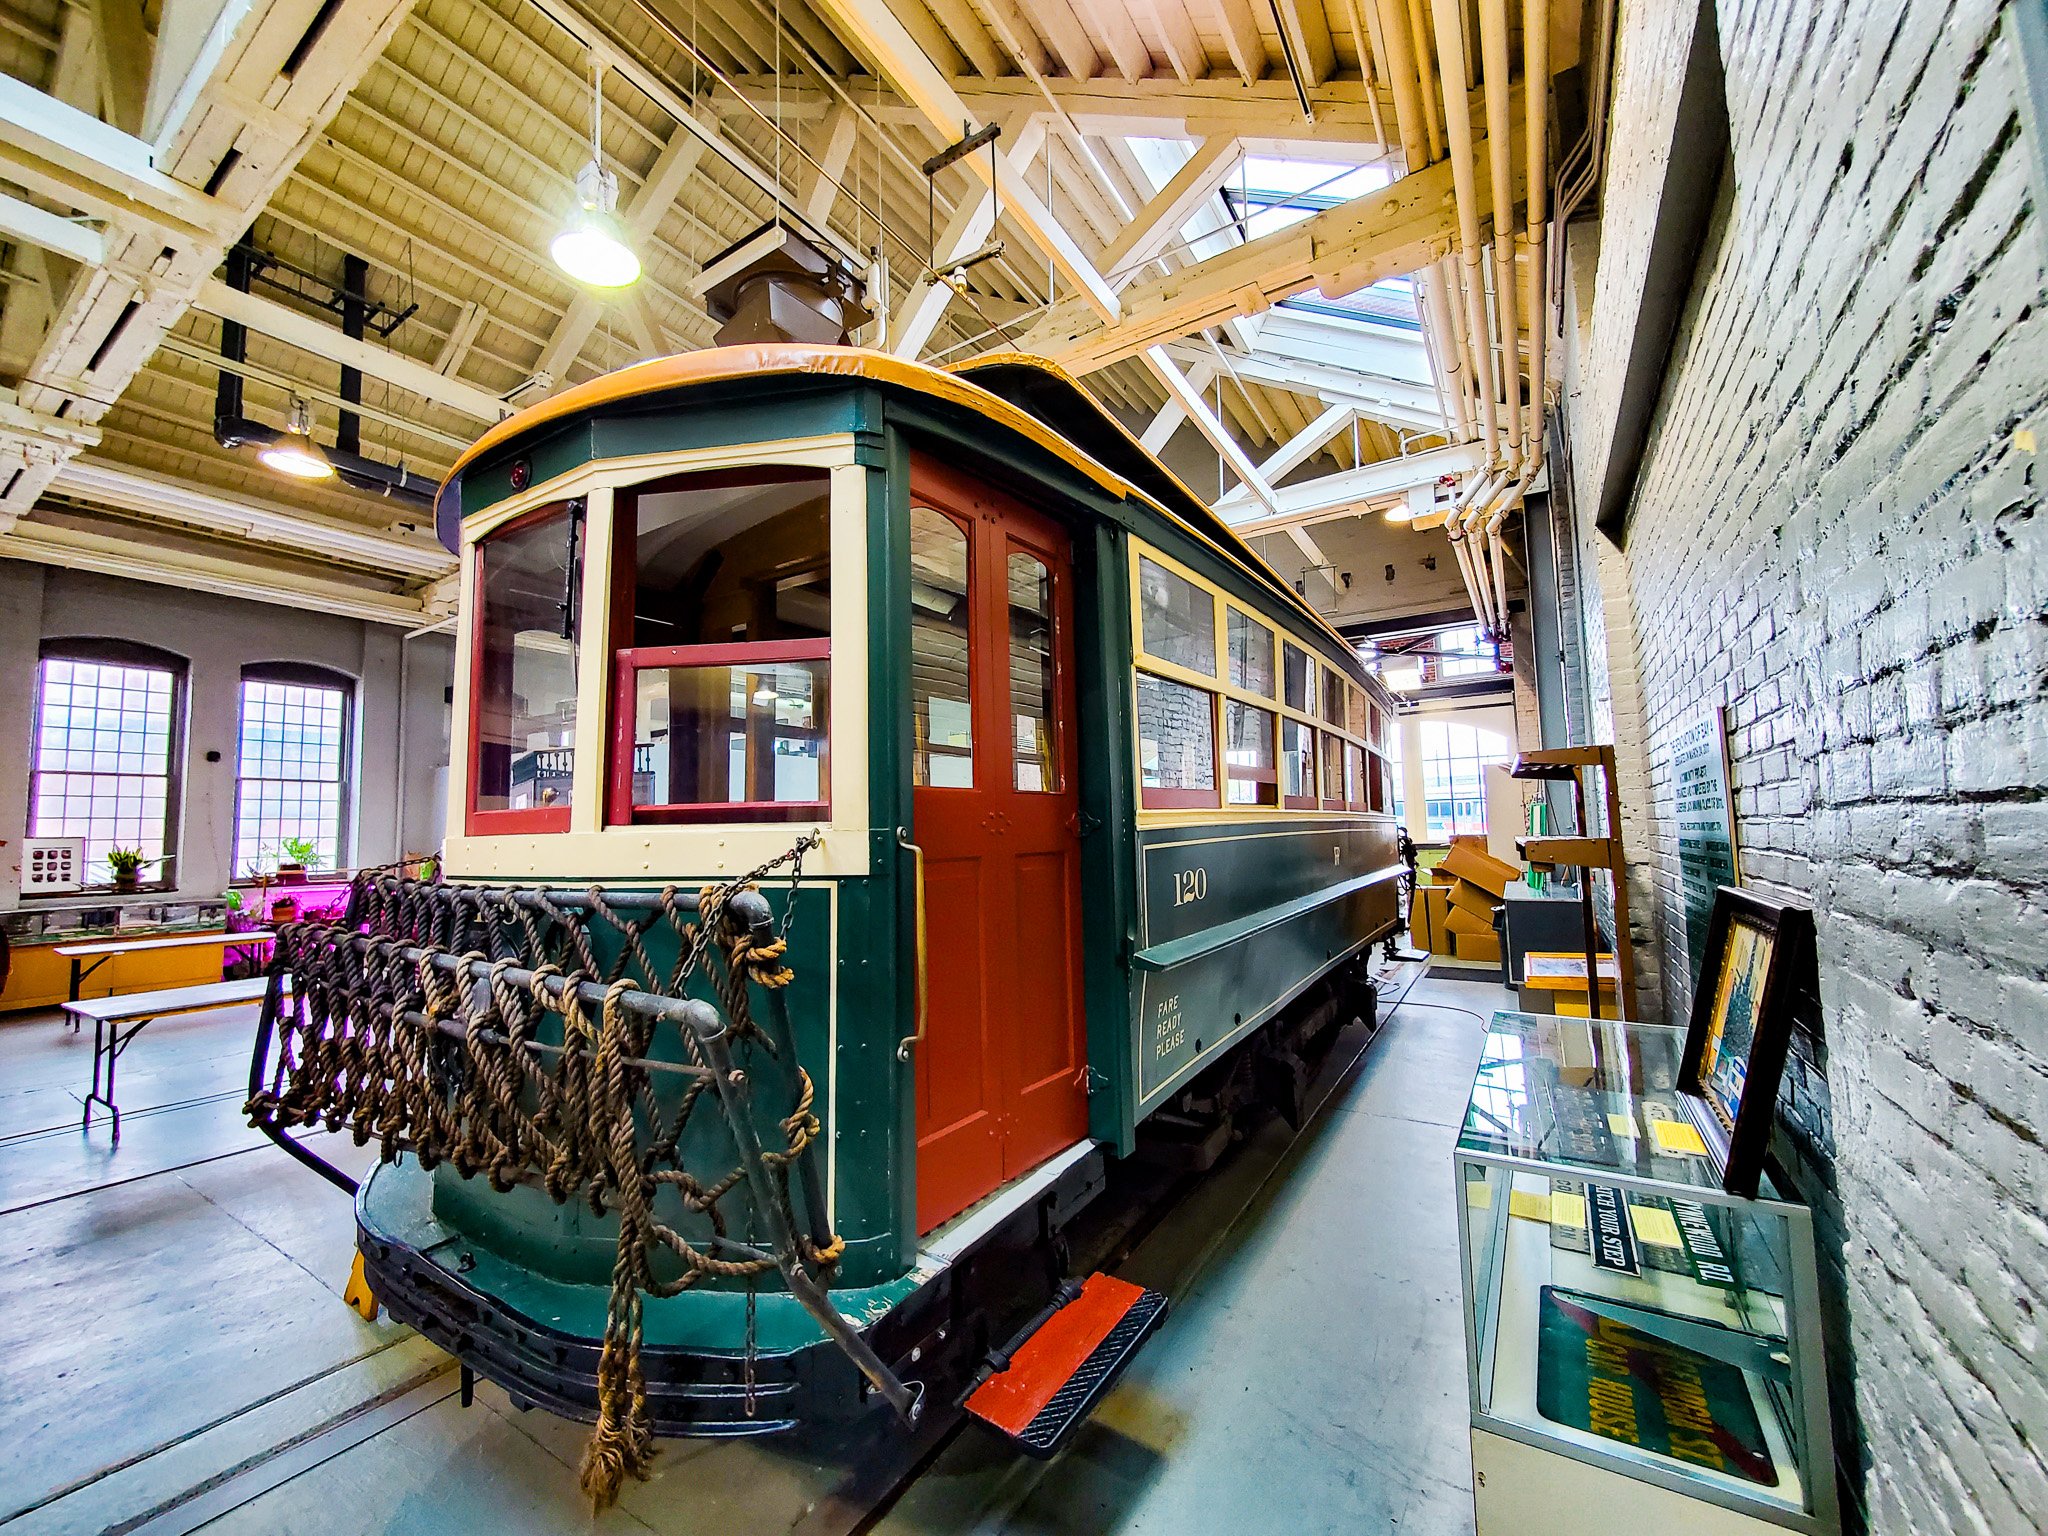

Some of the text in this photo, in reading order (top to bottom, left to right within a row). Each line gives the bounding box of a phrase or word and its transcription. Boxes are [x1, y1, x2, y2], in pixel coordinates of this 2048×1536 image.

[1173, 867, 1207, 907] 120
[1157, 994, 1179, 1019] FARE
[1156, 1011, 1182, 1040] READY
[1156, 1028, 1185, 1061] PLEASE
[1595, 1184, 1626, 1267] ATCH YOUR STEP
[1588, 1376, 1640, 1444] HOUSE
